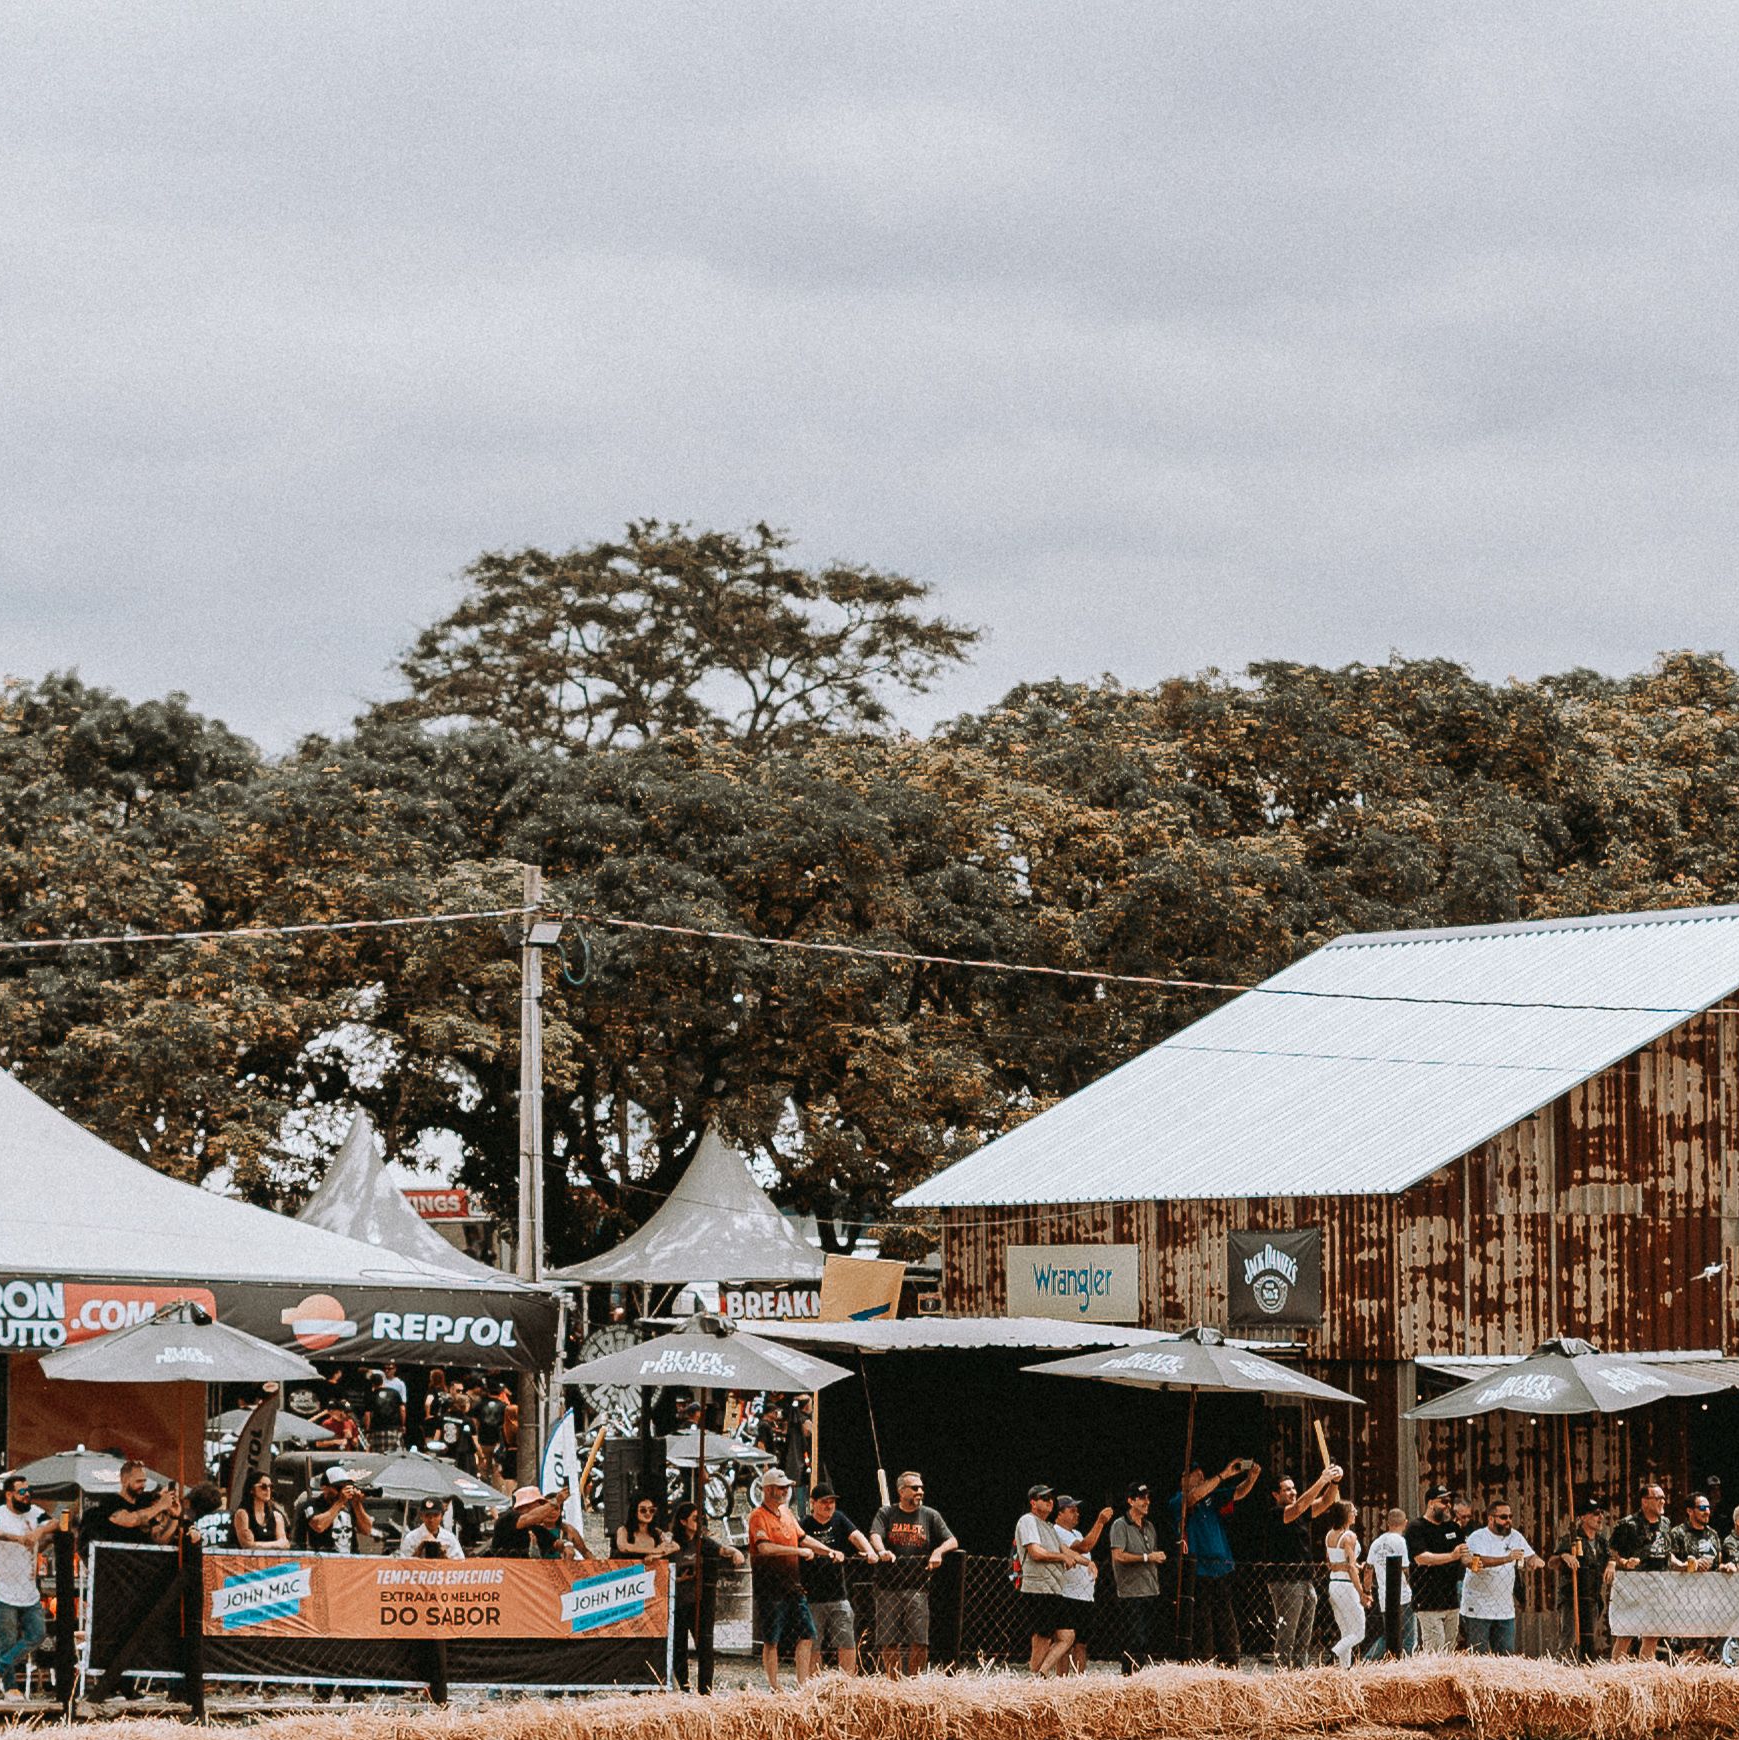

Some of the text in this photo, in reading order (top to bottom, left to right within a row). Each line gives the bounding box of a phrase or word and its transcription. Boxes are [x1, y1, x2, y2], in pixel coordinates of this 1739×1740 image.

[406, 1194, 461, 1213] INGS
[1032, 1261, 1113, 1313] Wrangler
[372, 1311, 517, 1348] REPSOL
[659, 1349, 726, 1366] BLACK
[639, 1360, 736, 1378] PRINCESS
[376, 1568, 505, 1585] TEMPEROS ESPECIAIS
[223, 1578, 300, 1609] JOHN MAC
[380, 1591, 500, 1603] EXTRAIA O MELHOR
[572, 1581, 645, 1612] JOHN MAC
[380, 1606, 501, 1626] DO SABOR
